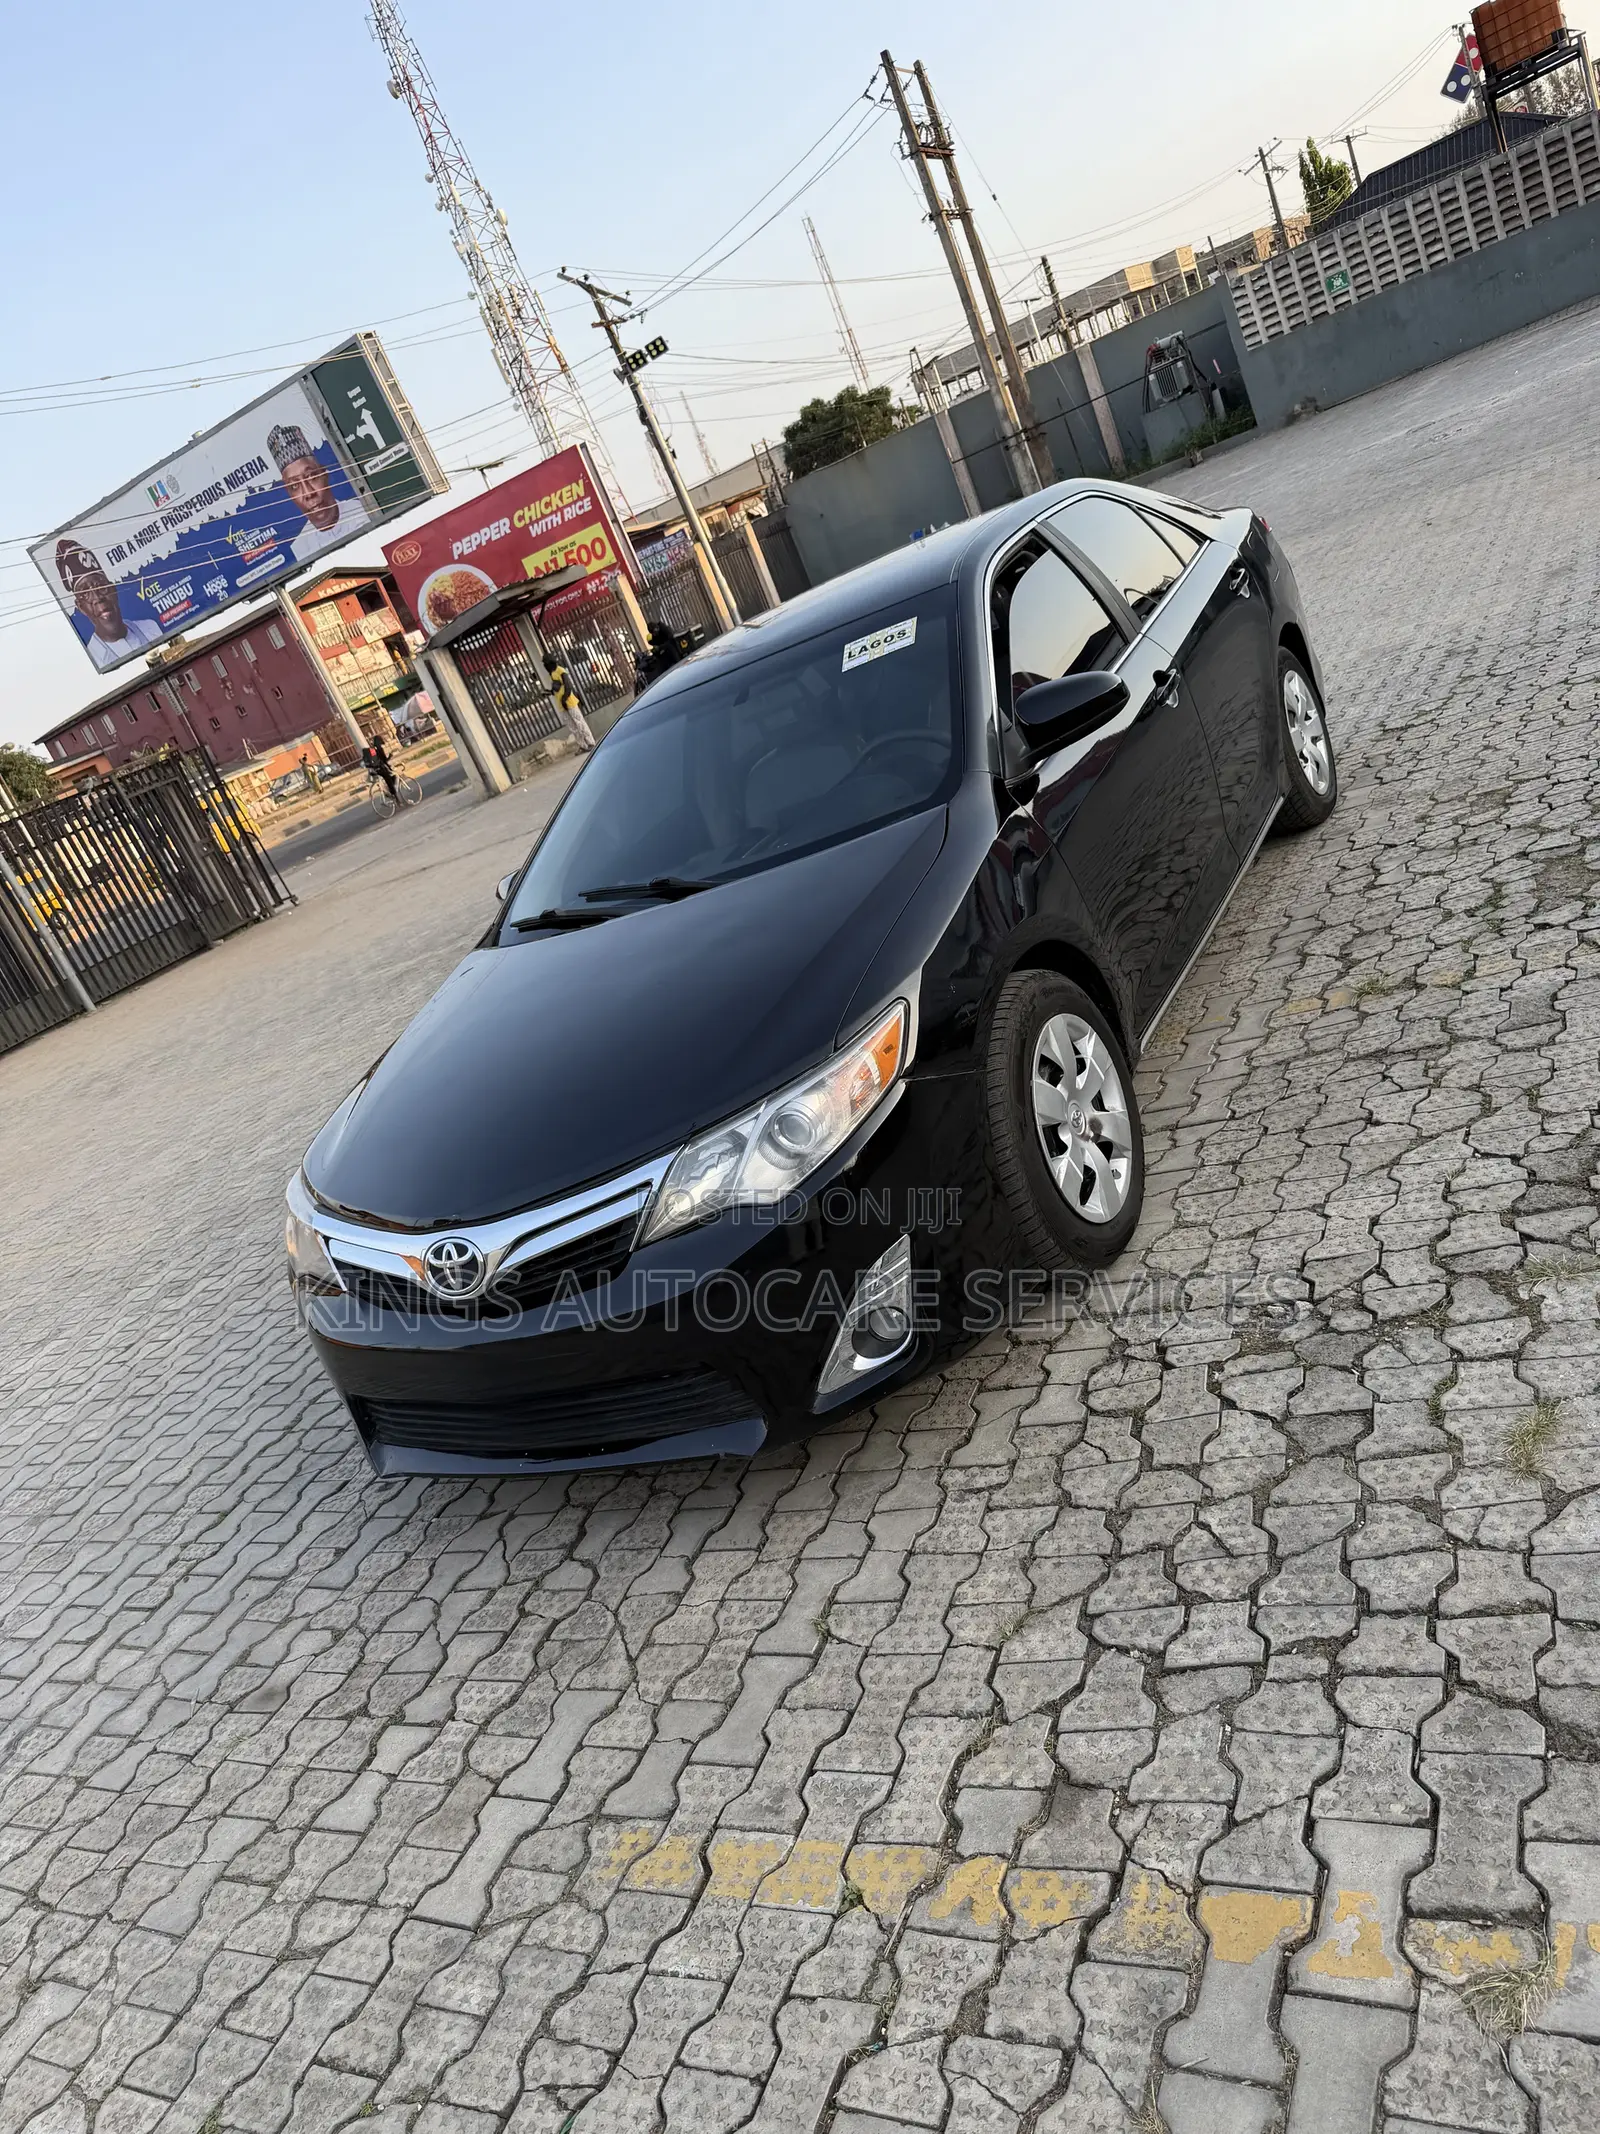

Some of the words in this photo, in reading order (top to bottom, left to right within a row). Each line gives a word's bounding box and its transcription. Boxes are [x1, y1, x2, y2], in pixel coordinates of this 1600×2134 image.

[105, 542, 128, 567] FOR
[125, 538, 137, 553] A
[132, 519, 163, 549] MORE
[160, 481, 228, 532] PROSPEROUS
[223, 455, 269, 493] NIGERIA
[452, 517, 511, 560] PEPPER
[513, 479, 585, 529] CHICKEN
[529, 513, 562, 538] WITH
[564, 497, 593, 522] RICE
[238, 527, 278, 552] SHETTIMA
[550, 546, 559, 557] As
[558, 543, 570, 554] low
[152, 582, 194, 614] TINUBU
[203, 578, 228, 598] Hope
[847, 629, 907, 660] LAGOS
